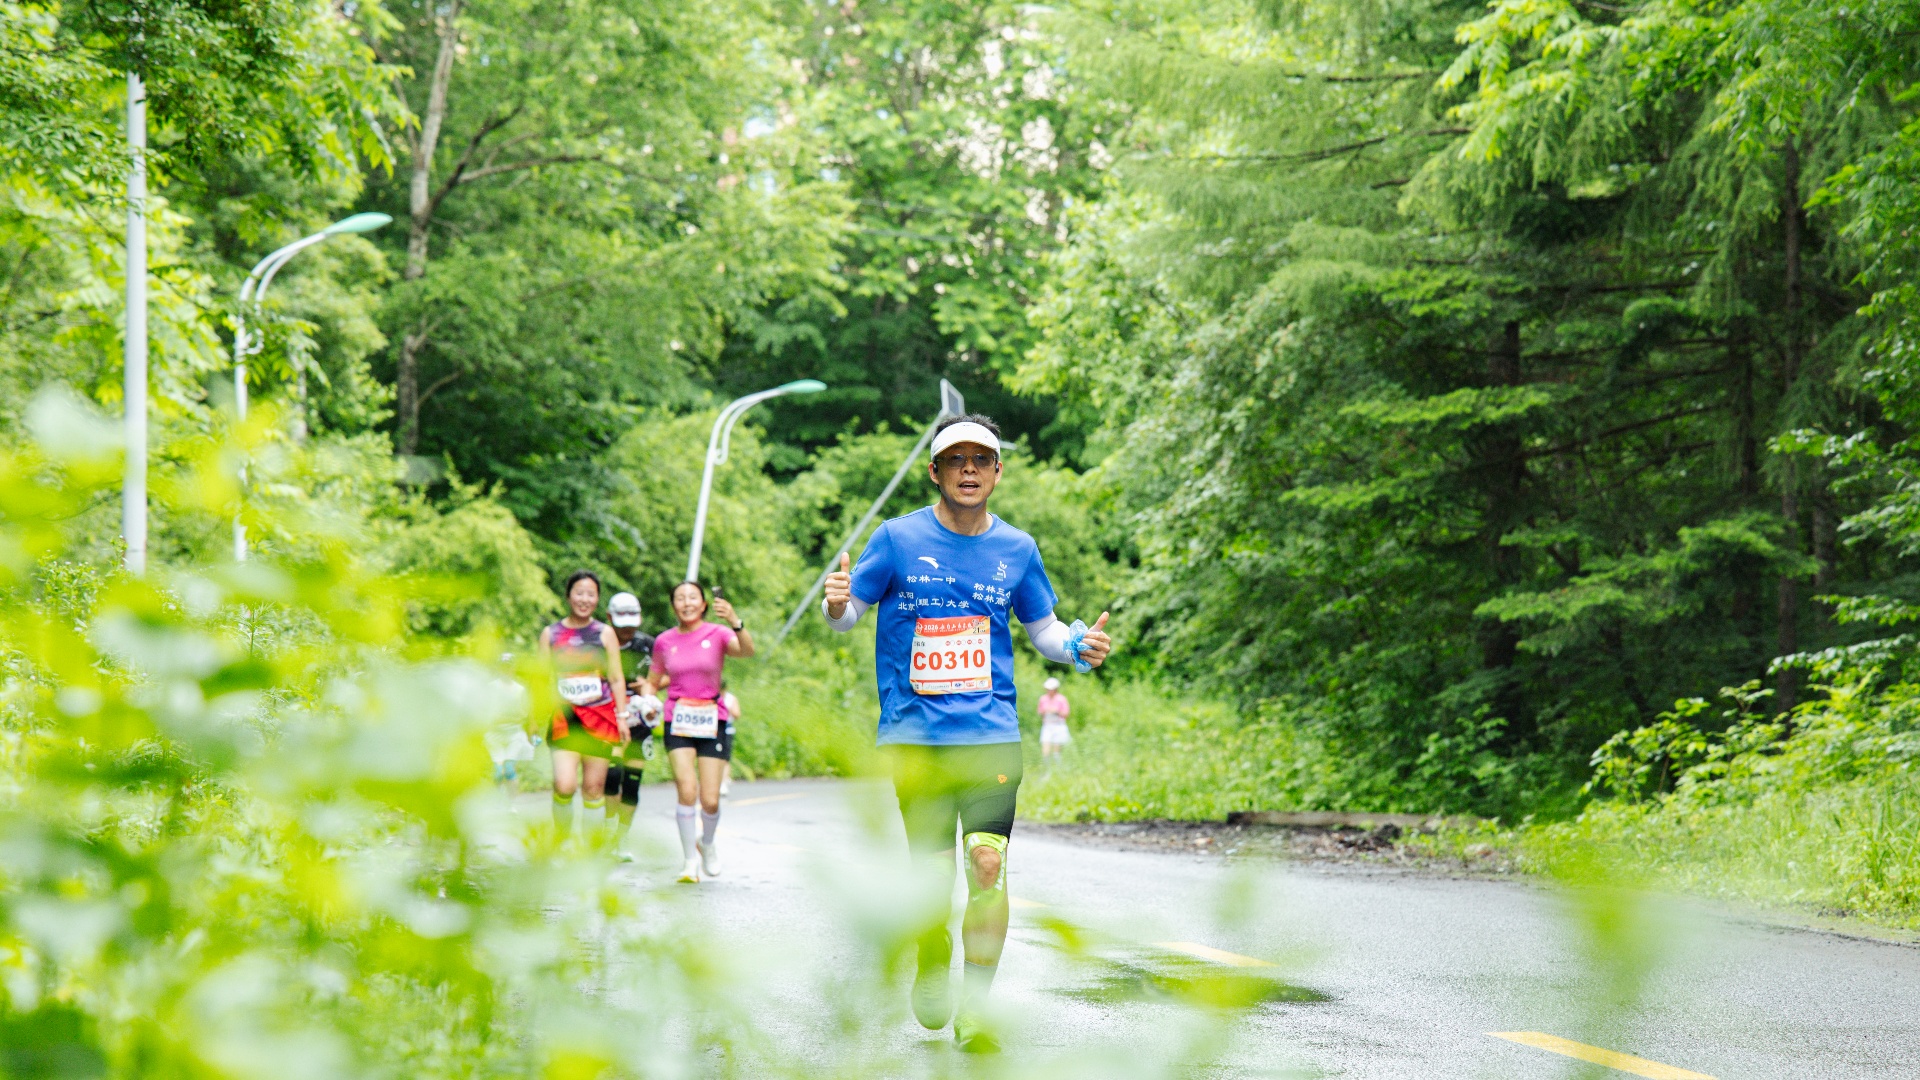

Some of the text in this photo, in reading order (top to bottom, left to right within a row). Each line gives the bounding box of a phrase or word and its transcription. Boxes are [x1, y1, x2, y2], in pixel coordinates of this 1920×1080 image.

[907, 575, 956, 585] 松林一中
[924, 623, 939, 631] 2026
[913, 649, 986, 671] C0310
